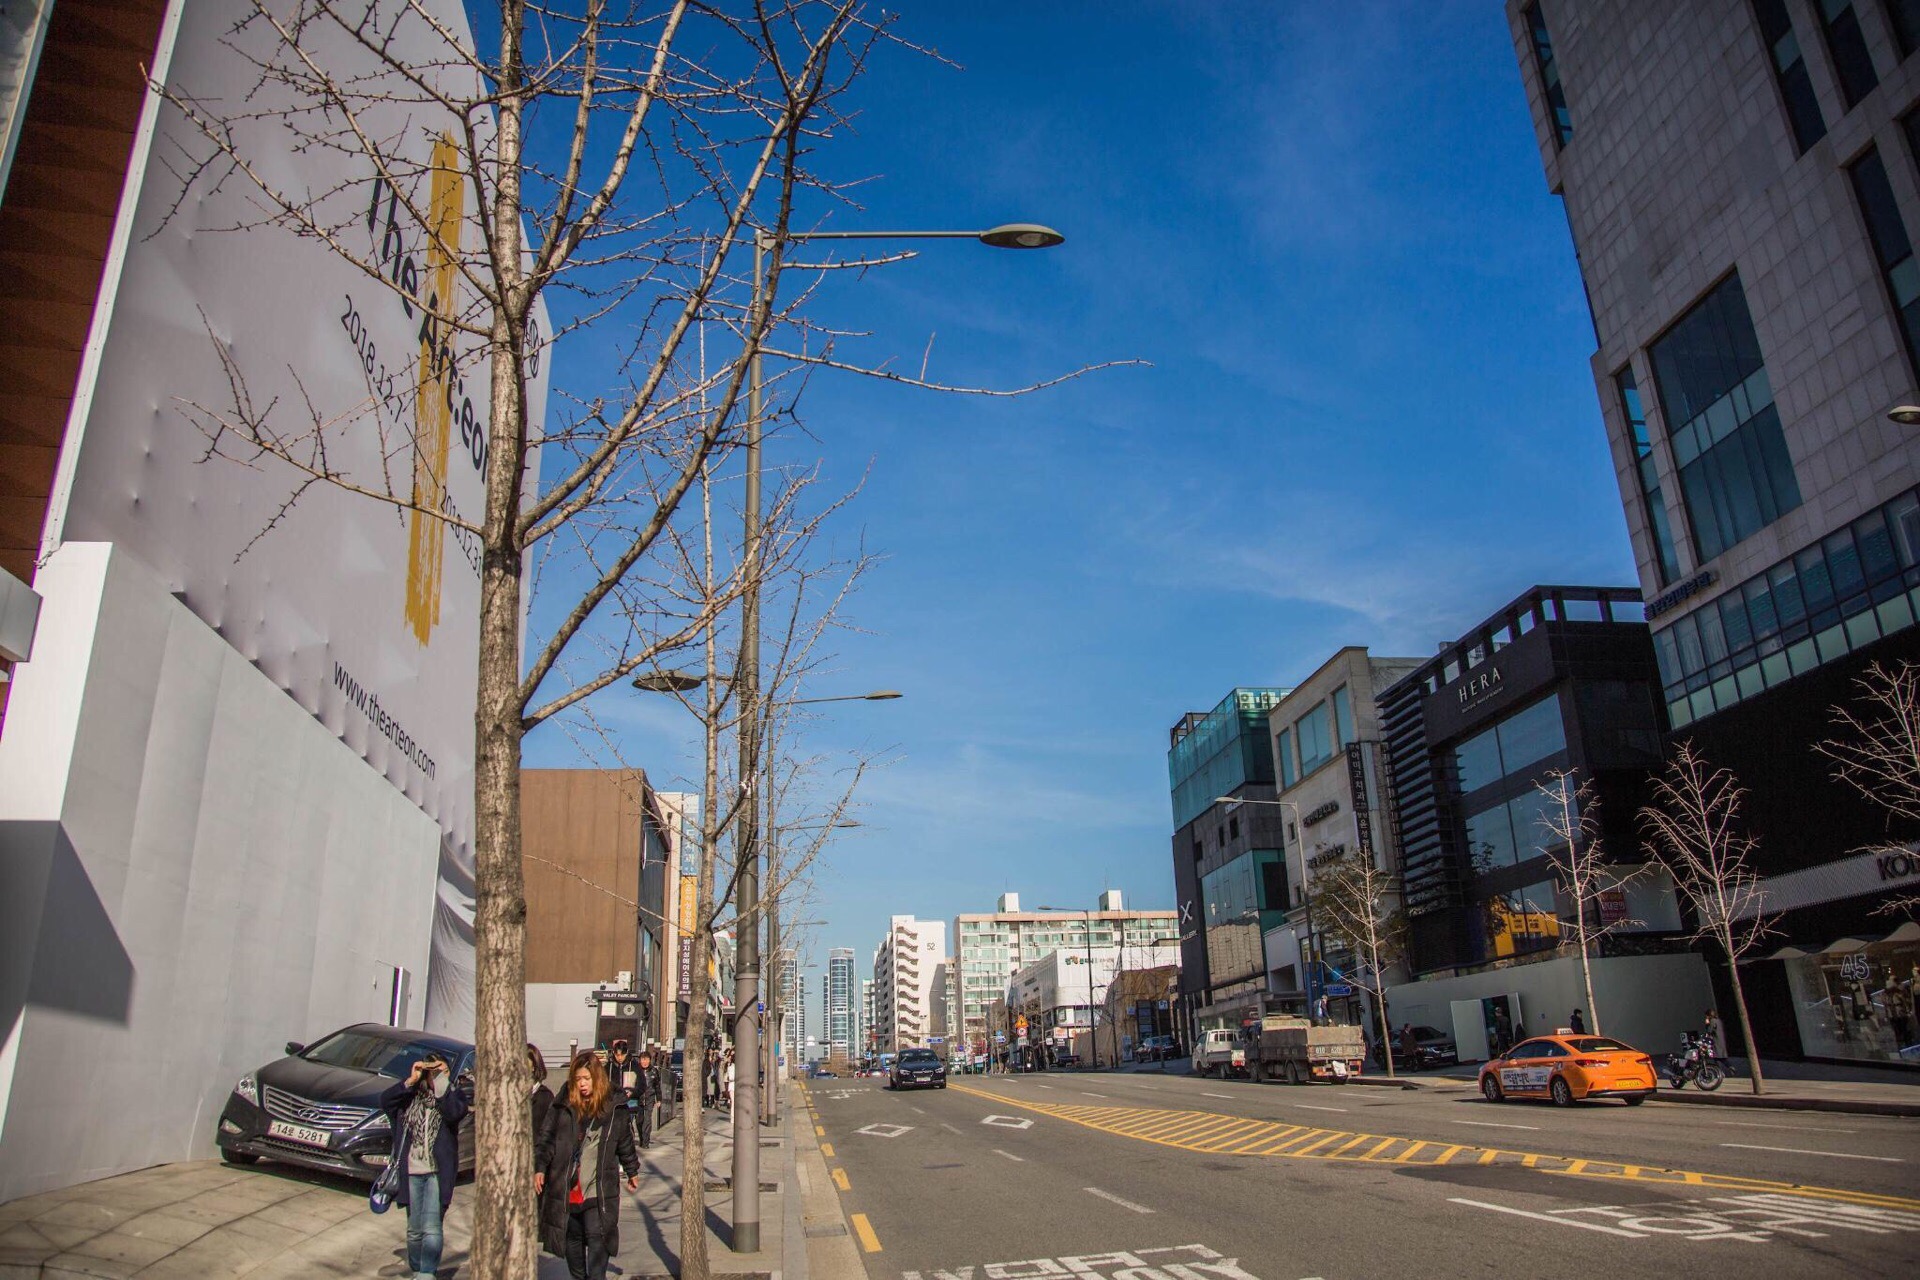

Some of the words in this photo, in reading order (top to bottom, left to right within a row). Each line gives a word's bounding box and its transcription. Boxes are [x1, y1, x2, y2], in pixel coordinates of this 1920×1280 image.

[367, 141, 418, 320] The
[1458, 667, 1501, 703] HERA
[333, 661, 436, 781] www.thearteon.com
[1840, 953, 1870, 980] 45
[298, 1128, 324, 1143] 5281
